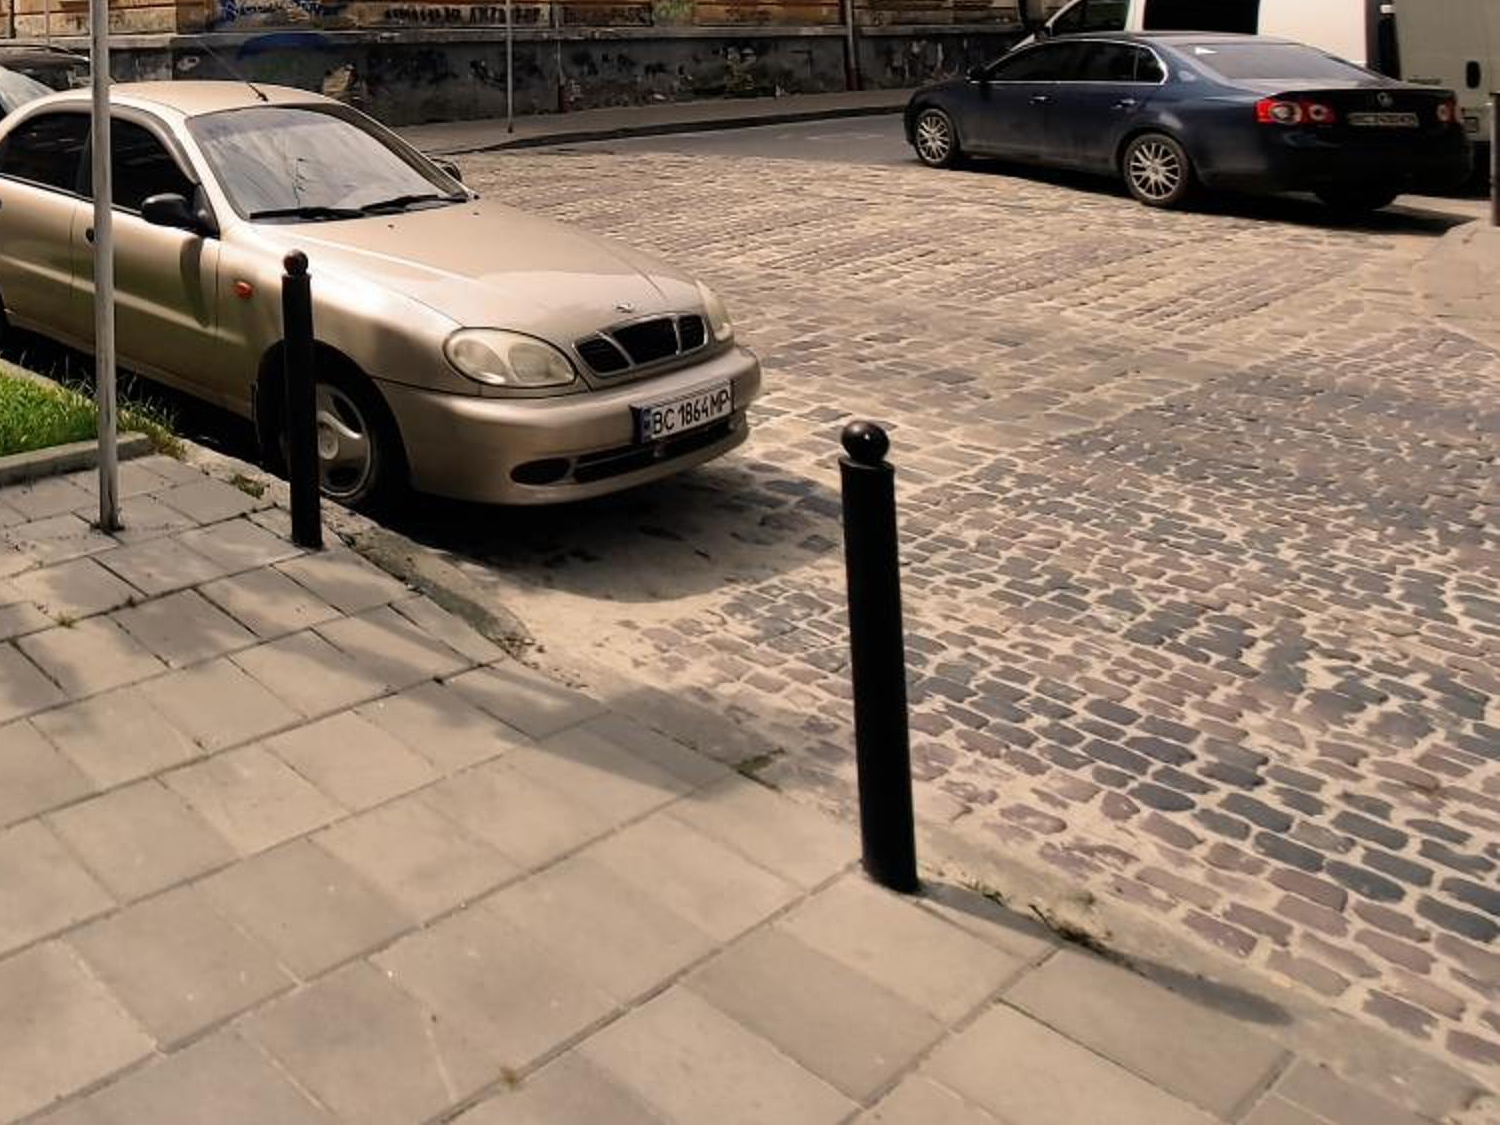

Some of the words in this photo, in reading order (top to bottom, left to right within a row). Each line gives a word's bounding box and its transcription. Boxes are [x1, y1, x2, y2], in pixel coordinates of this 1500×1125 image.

[652, 408, 675, 434] BC
[678, 399, 709, 427] 1864
[710, 388, 730, 416] MP
